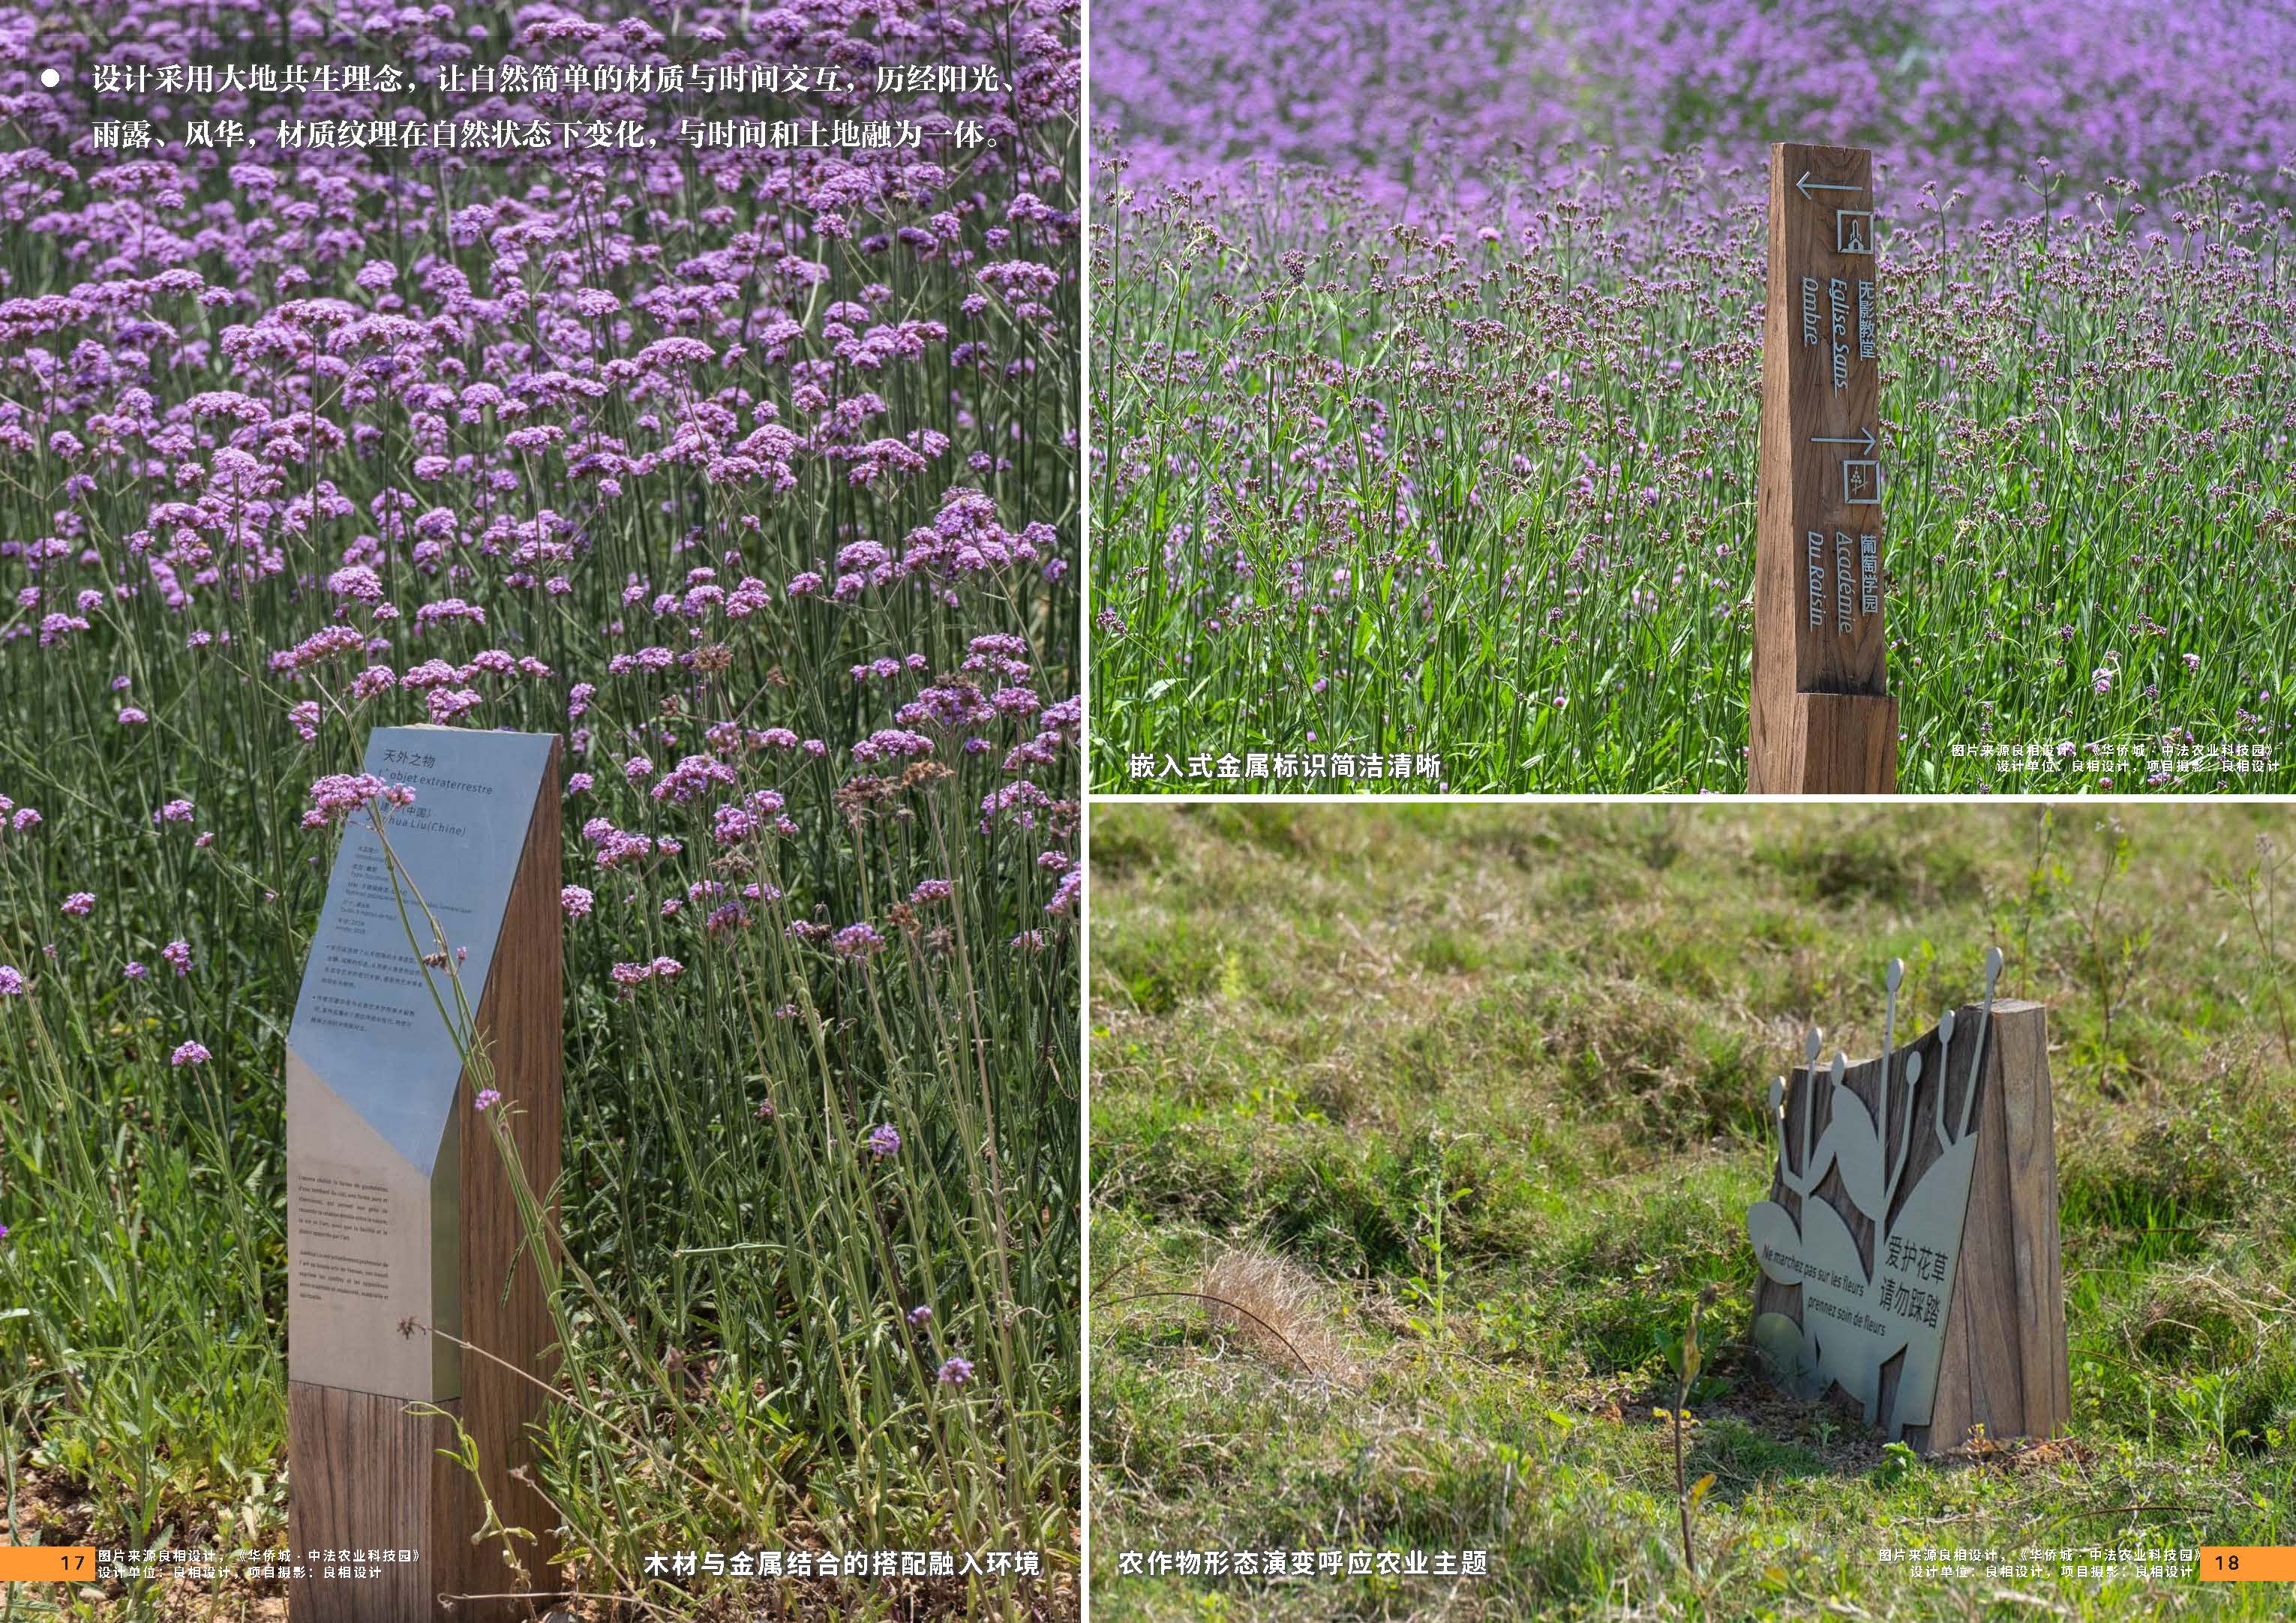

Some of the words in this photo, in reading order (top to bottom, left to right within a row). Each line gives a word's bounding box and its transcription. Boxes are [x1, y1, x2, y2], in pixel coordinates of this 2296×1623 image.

[1829, 278, 1850, 336] Eglise
[1835, 342, 1850, 388] Sans
[1808, 531, 1823, 559] Du
[1810, 565, 1826, 626] Raisin
[1836, 530, 1856, 633] Académie
[383, 748, 437, 770] 天外之物
[419, 775, 493, 795] extraterrestre
[1763, 1243, 1772, 1262] Ne
[1773, 1250, 1804, 1274] marchez
[1803, 1263, 1817, 1279] pas
[1817, 1268, 1831, 1282] sur
[1830, 1270, 1841, 1288] les
[1842, 1274, 1864, 1298] fleurs
[1885, 1235, 1948, 1284] 爱护花草
[1837, 1305, 1852, 1322] soin
[1853, 1310, 1864, 1328] de
[1864, 1314, 1886, 1337] fleurs
[1880, 1276, 1940, 1328] 请勿踩踏
